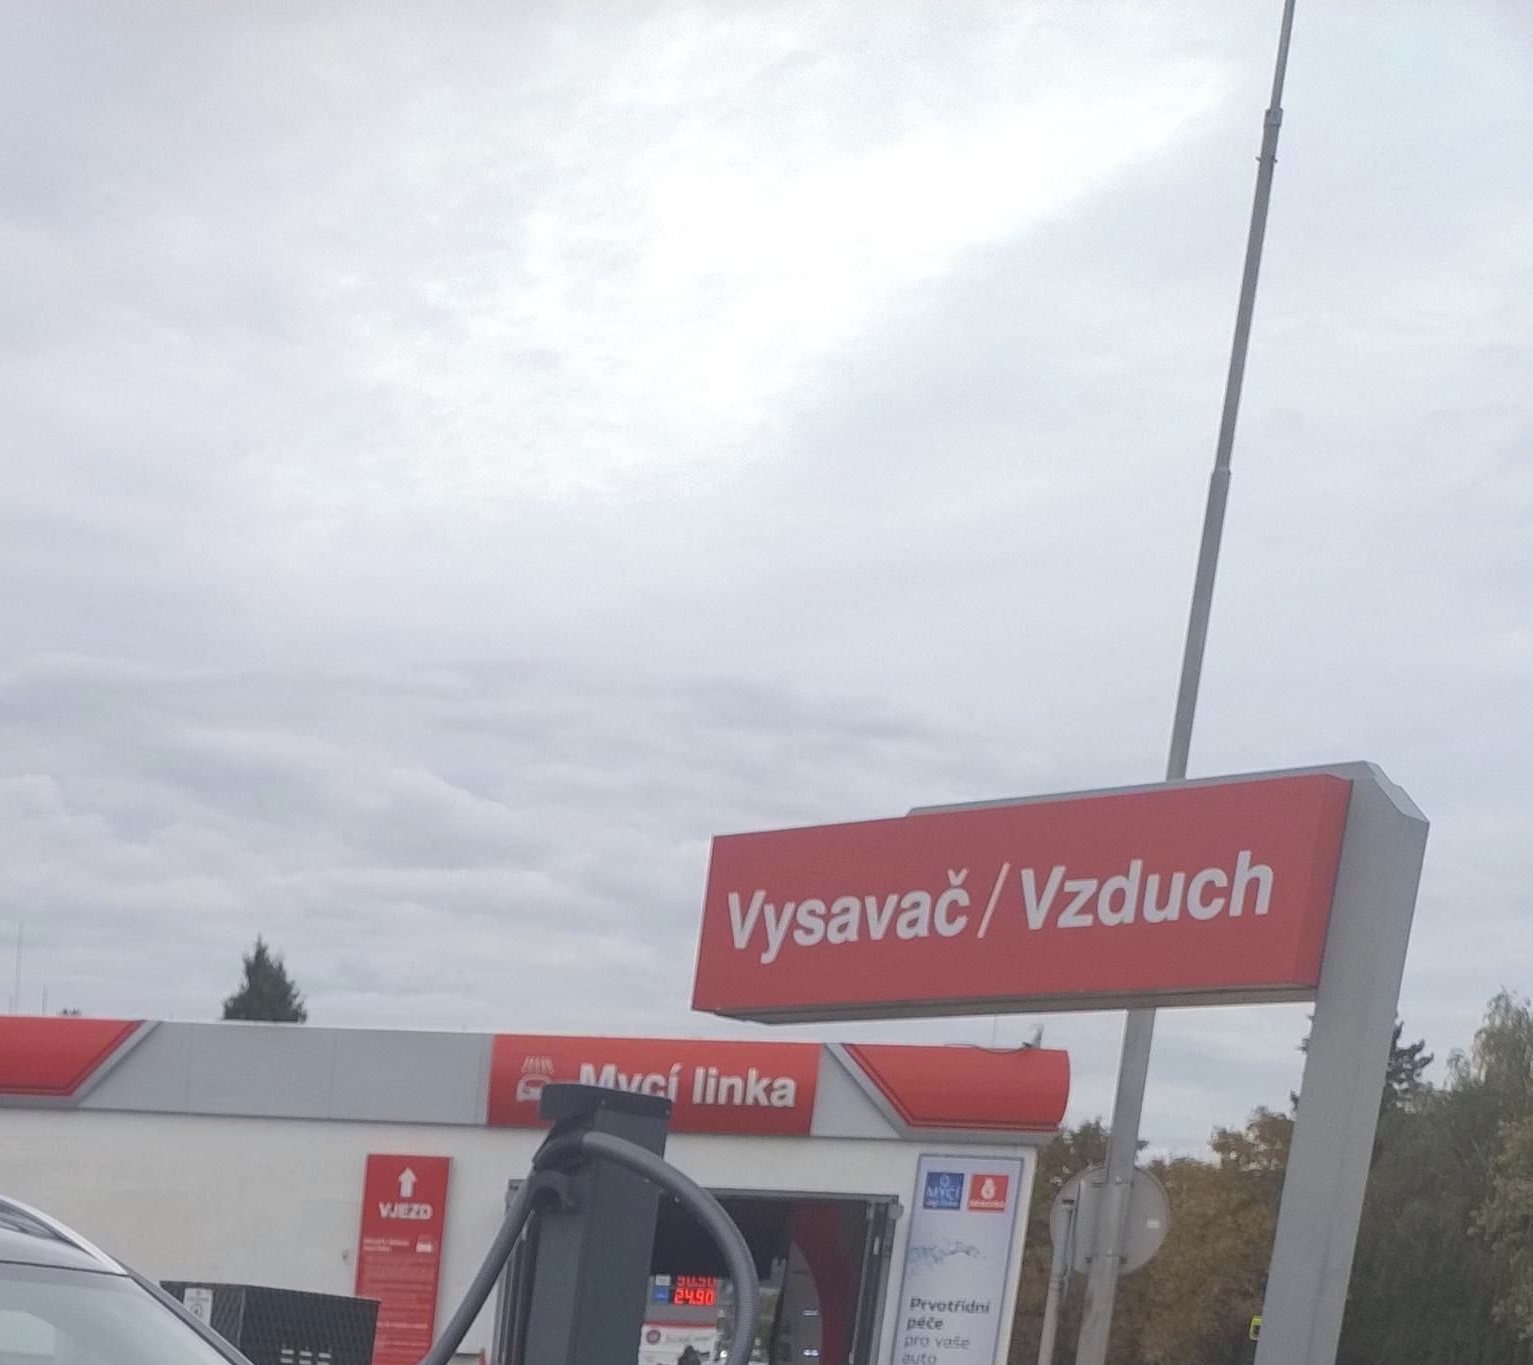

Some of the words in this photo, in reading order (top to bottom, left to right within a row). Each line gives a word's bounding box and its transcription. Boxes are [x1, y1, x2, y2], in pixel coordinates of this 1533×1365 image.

[727, 867, 971, 965] Vysavač
[1020, 849, 1274, 930] Vzduch
[692, 1066, 797, 1108] linka
[378, 1201, 434, 1220] VJEZD
[904, 1335, 930, 1348] pro
[902, 1353, 937, 1365] auto
